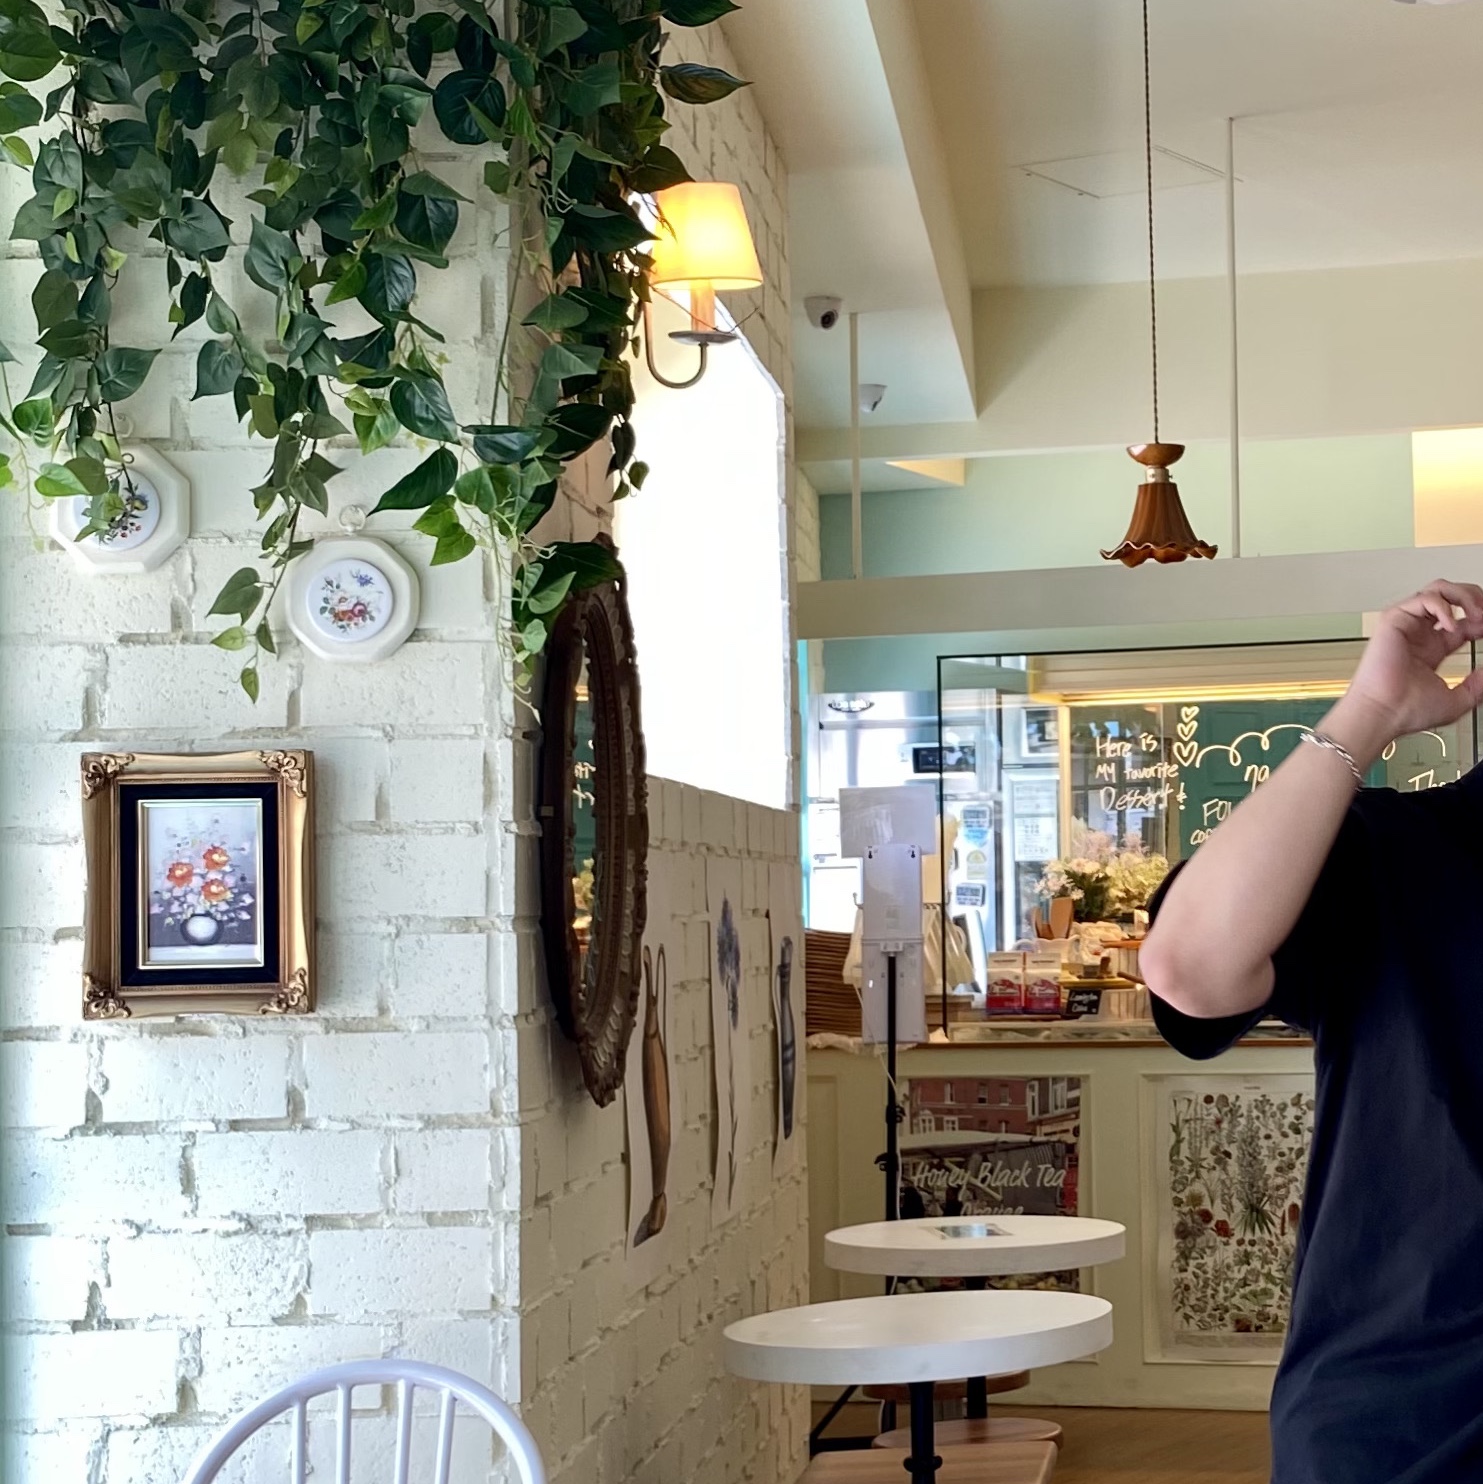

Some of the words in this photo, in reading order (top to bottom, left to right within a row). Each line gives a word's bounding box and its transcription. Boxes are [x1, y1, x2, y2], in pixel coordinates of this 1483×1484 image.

[1096, 735, 1133, 758] Here
[1140, 732, 1158, 753] is
[1123, 761, 1179, 780] favorite
[913, 1161, 971, 1203] Honey
[976, 1160, 1033, 1188] Black
[1037, 1163, 1067, 1188] Tea
